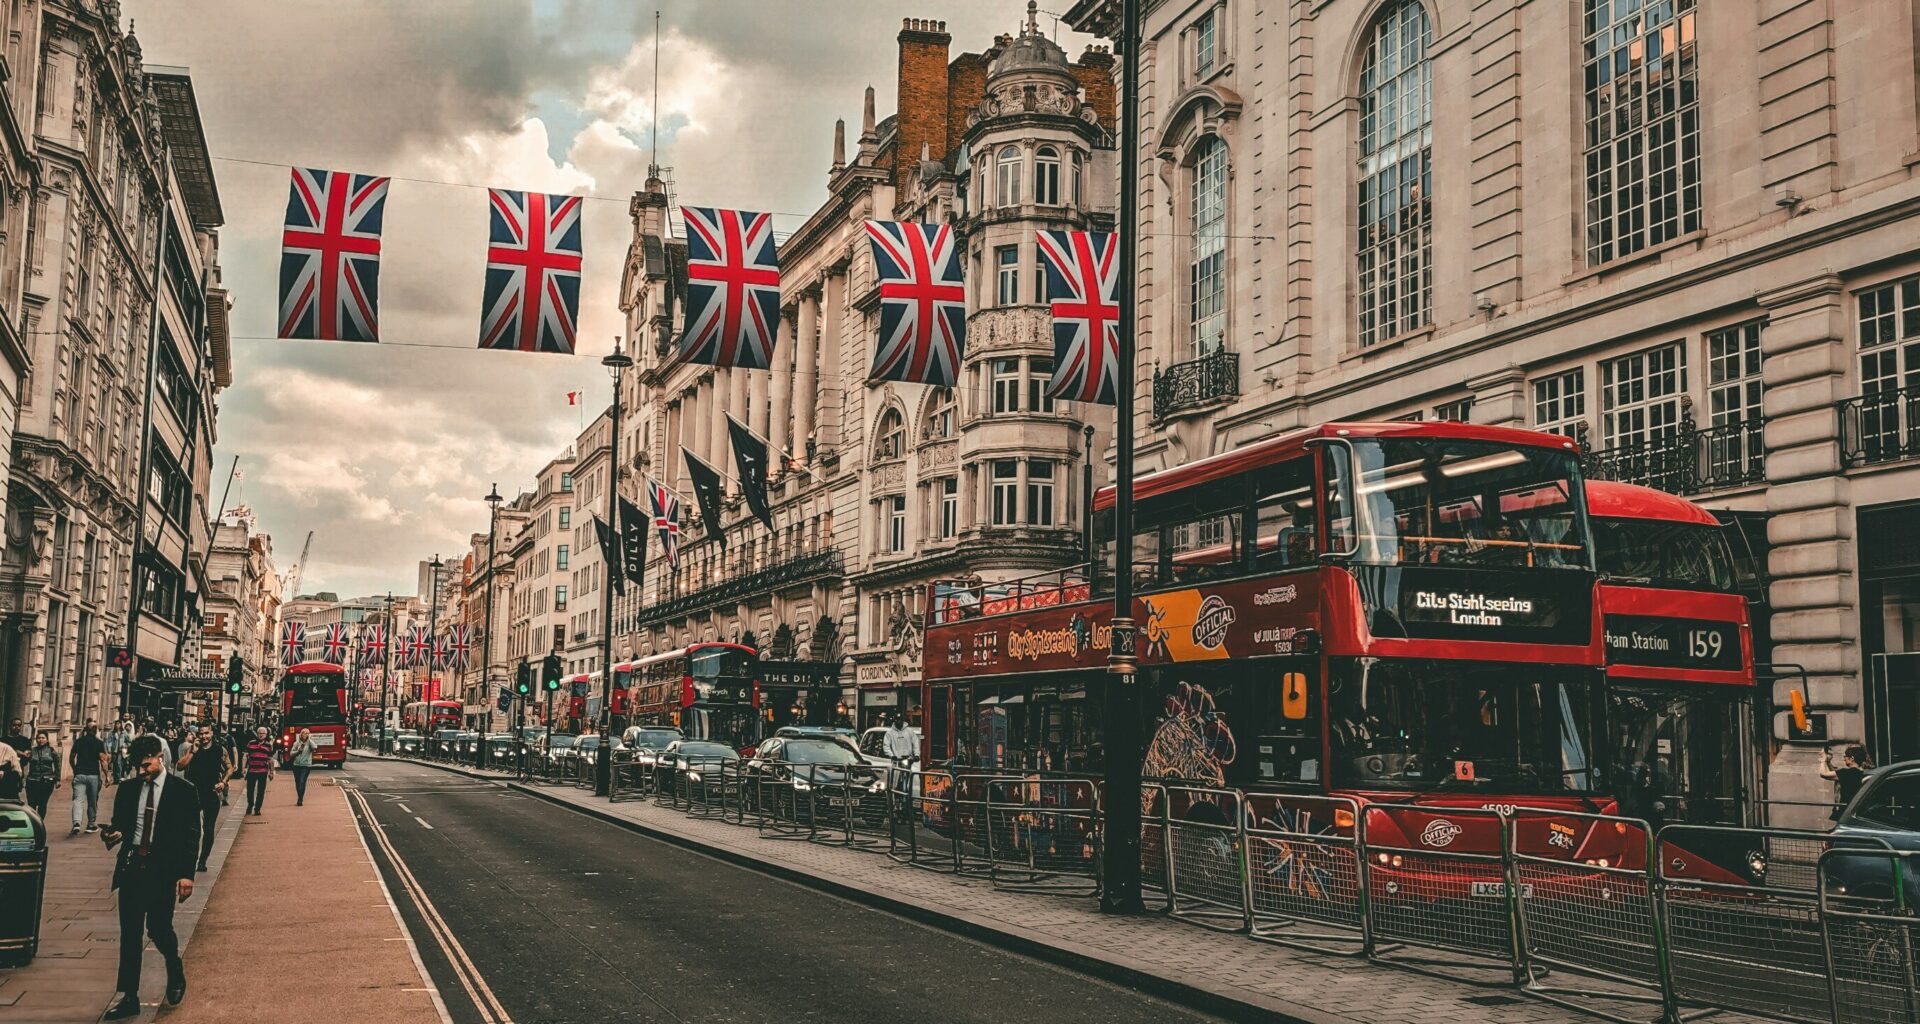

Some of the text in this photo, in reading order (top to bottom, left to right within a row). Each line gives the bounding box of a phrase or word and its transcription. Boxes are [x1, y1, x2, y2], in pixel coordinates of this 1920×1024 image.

[629, 523, 638, 572] DILLY
[1416, 592, 1532, 612] City Sightseeing
[1195, 608, 1233, 640] OFFICIAL
[1451, 610, 1501, 626] London
[1208, 629, 1225, 646] TOUR
[1604, 630, 1722, 658] ham Station 159
[764, 674, 788, 683] THE
[1123, 674, 1135, 684] 81
[312, 685, 319, 694] 6
[739, 688, 746, 698] 6
[1462, 762, 1468, 776] 6
[1425, 826, 1459, 842] OFFICIAL
